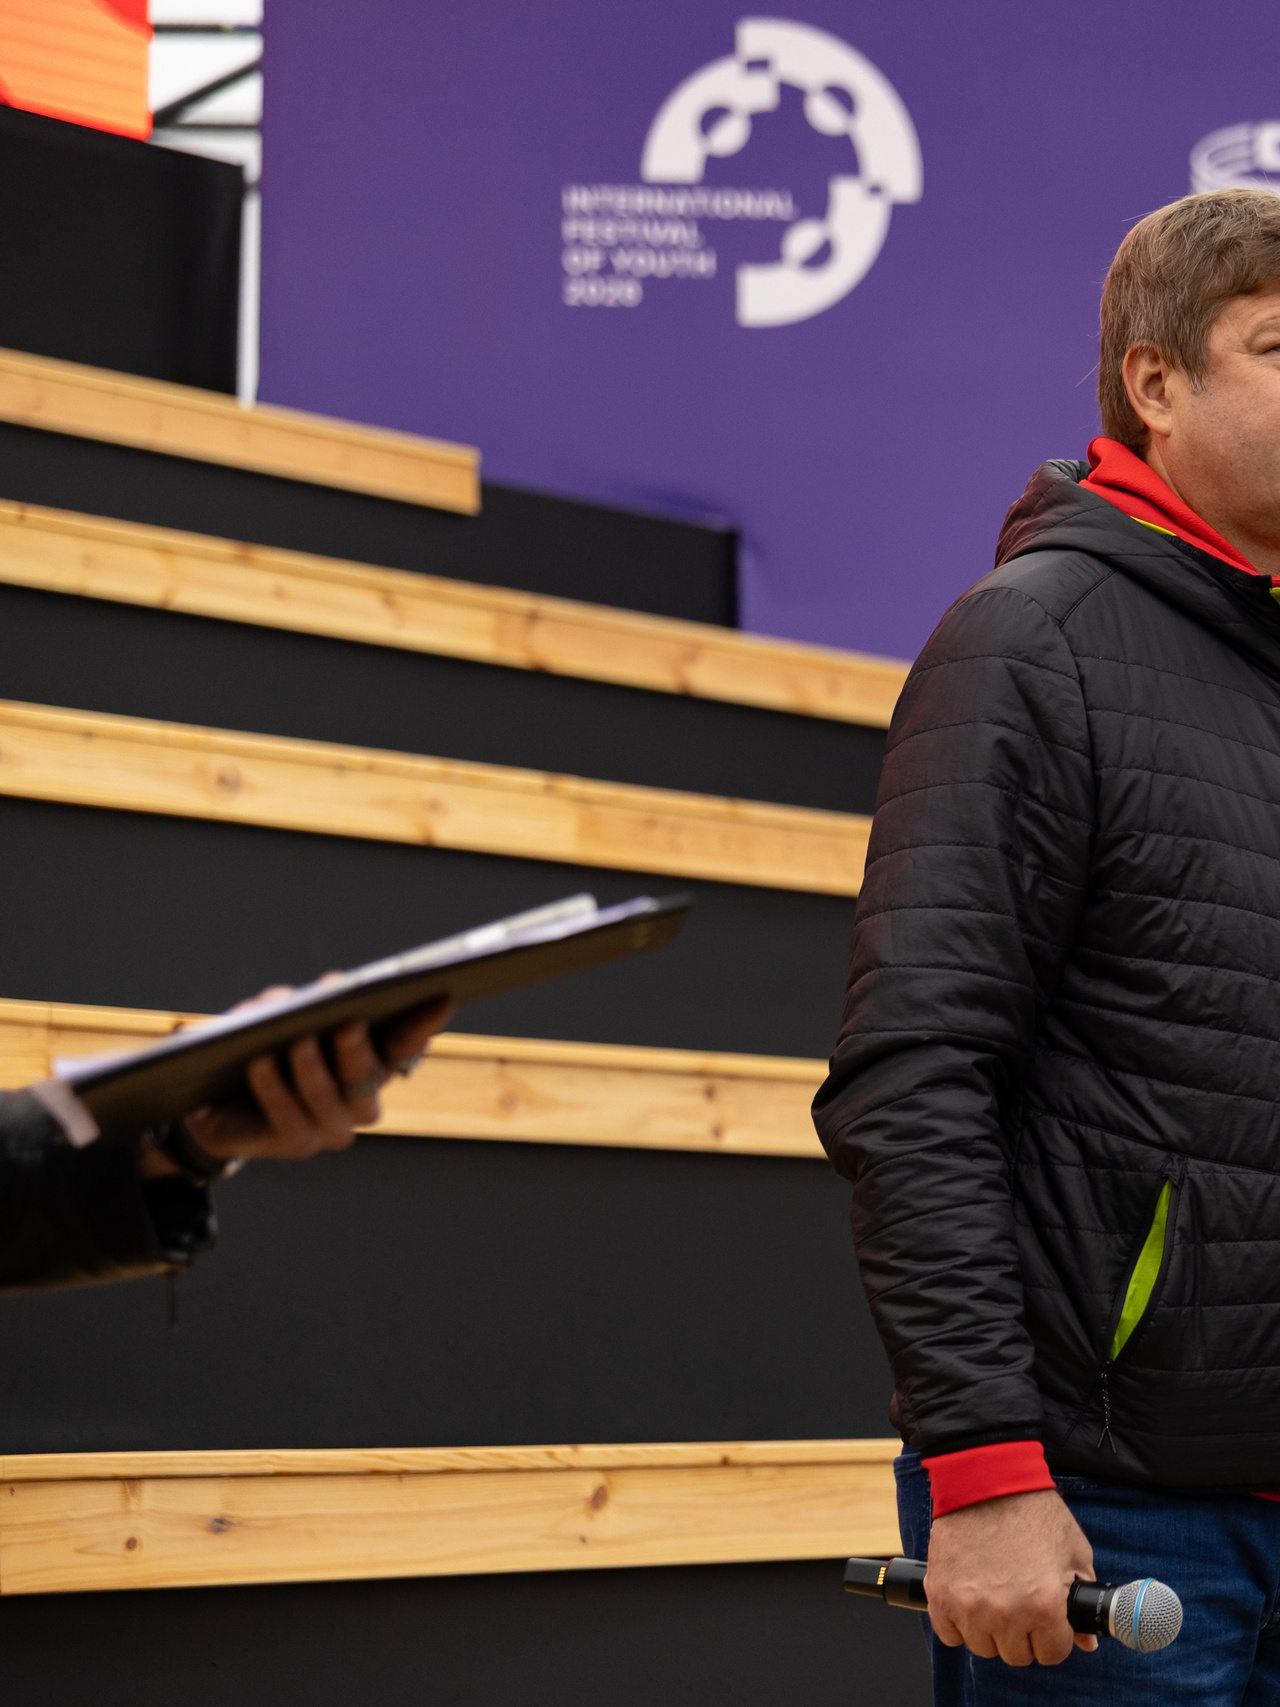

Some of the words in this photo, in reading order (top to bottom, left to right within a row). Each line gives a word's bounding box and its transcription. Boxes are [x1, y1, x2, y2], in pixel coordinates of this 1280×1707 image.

[561, 184, 797, 221] INTERNATIONAL
[561, 214, 704, 248] FESTIVAL
[561, 245, 606, 276] OF
[609, 246, 718, 279] YOUTH
